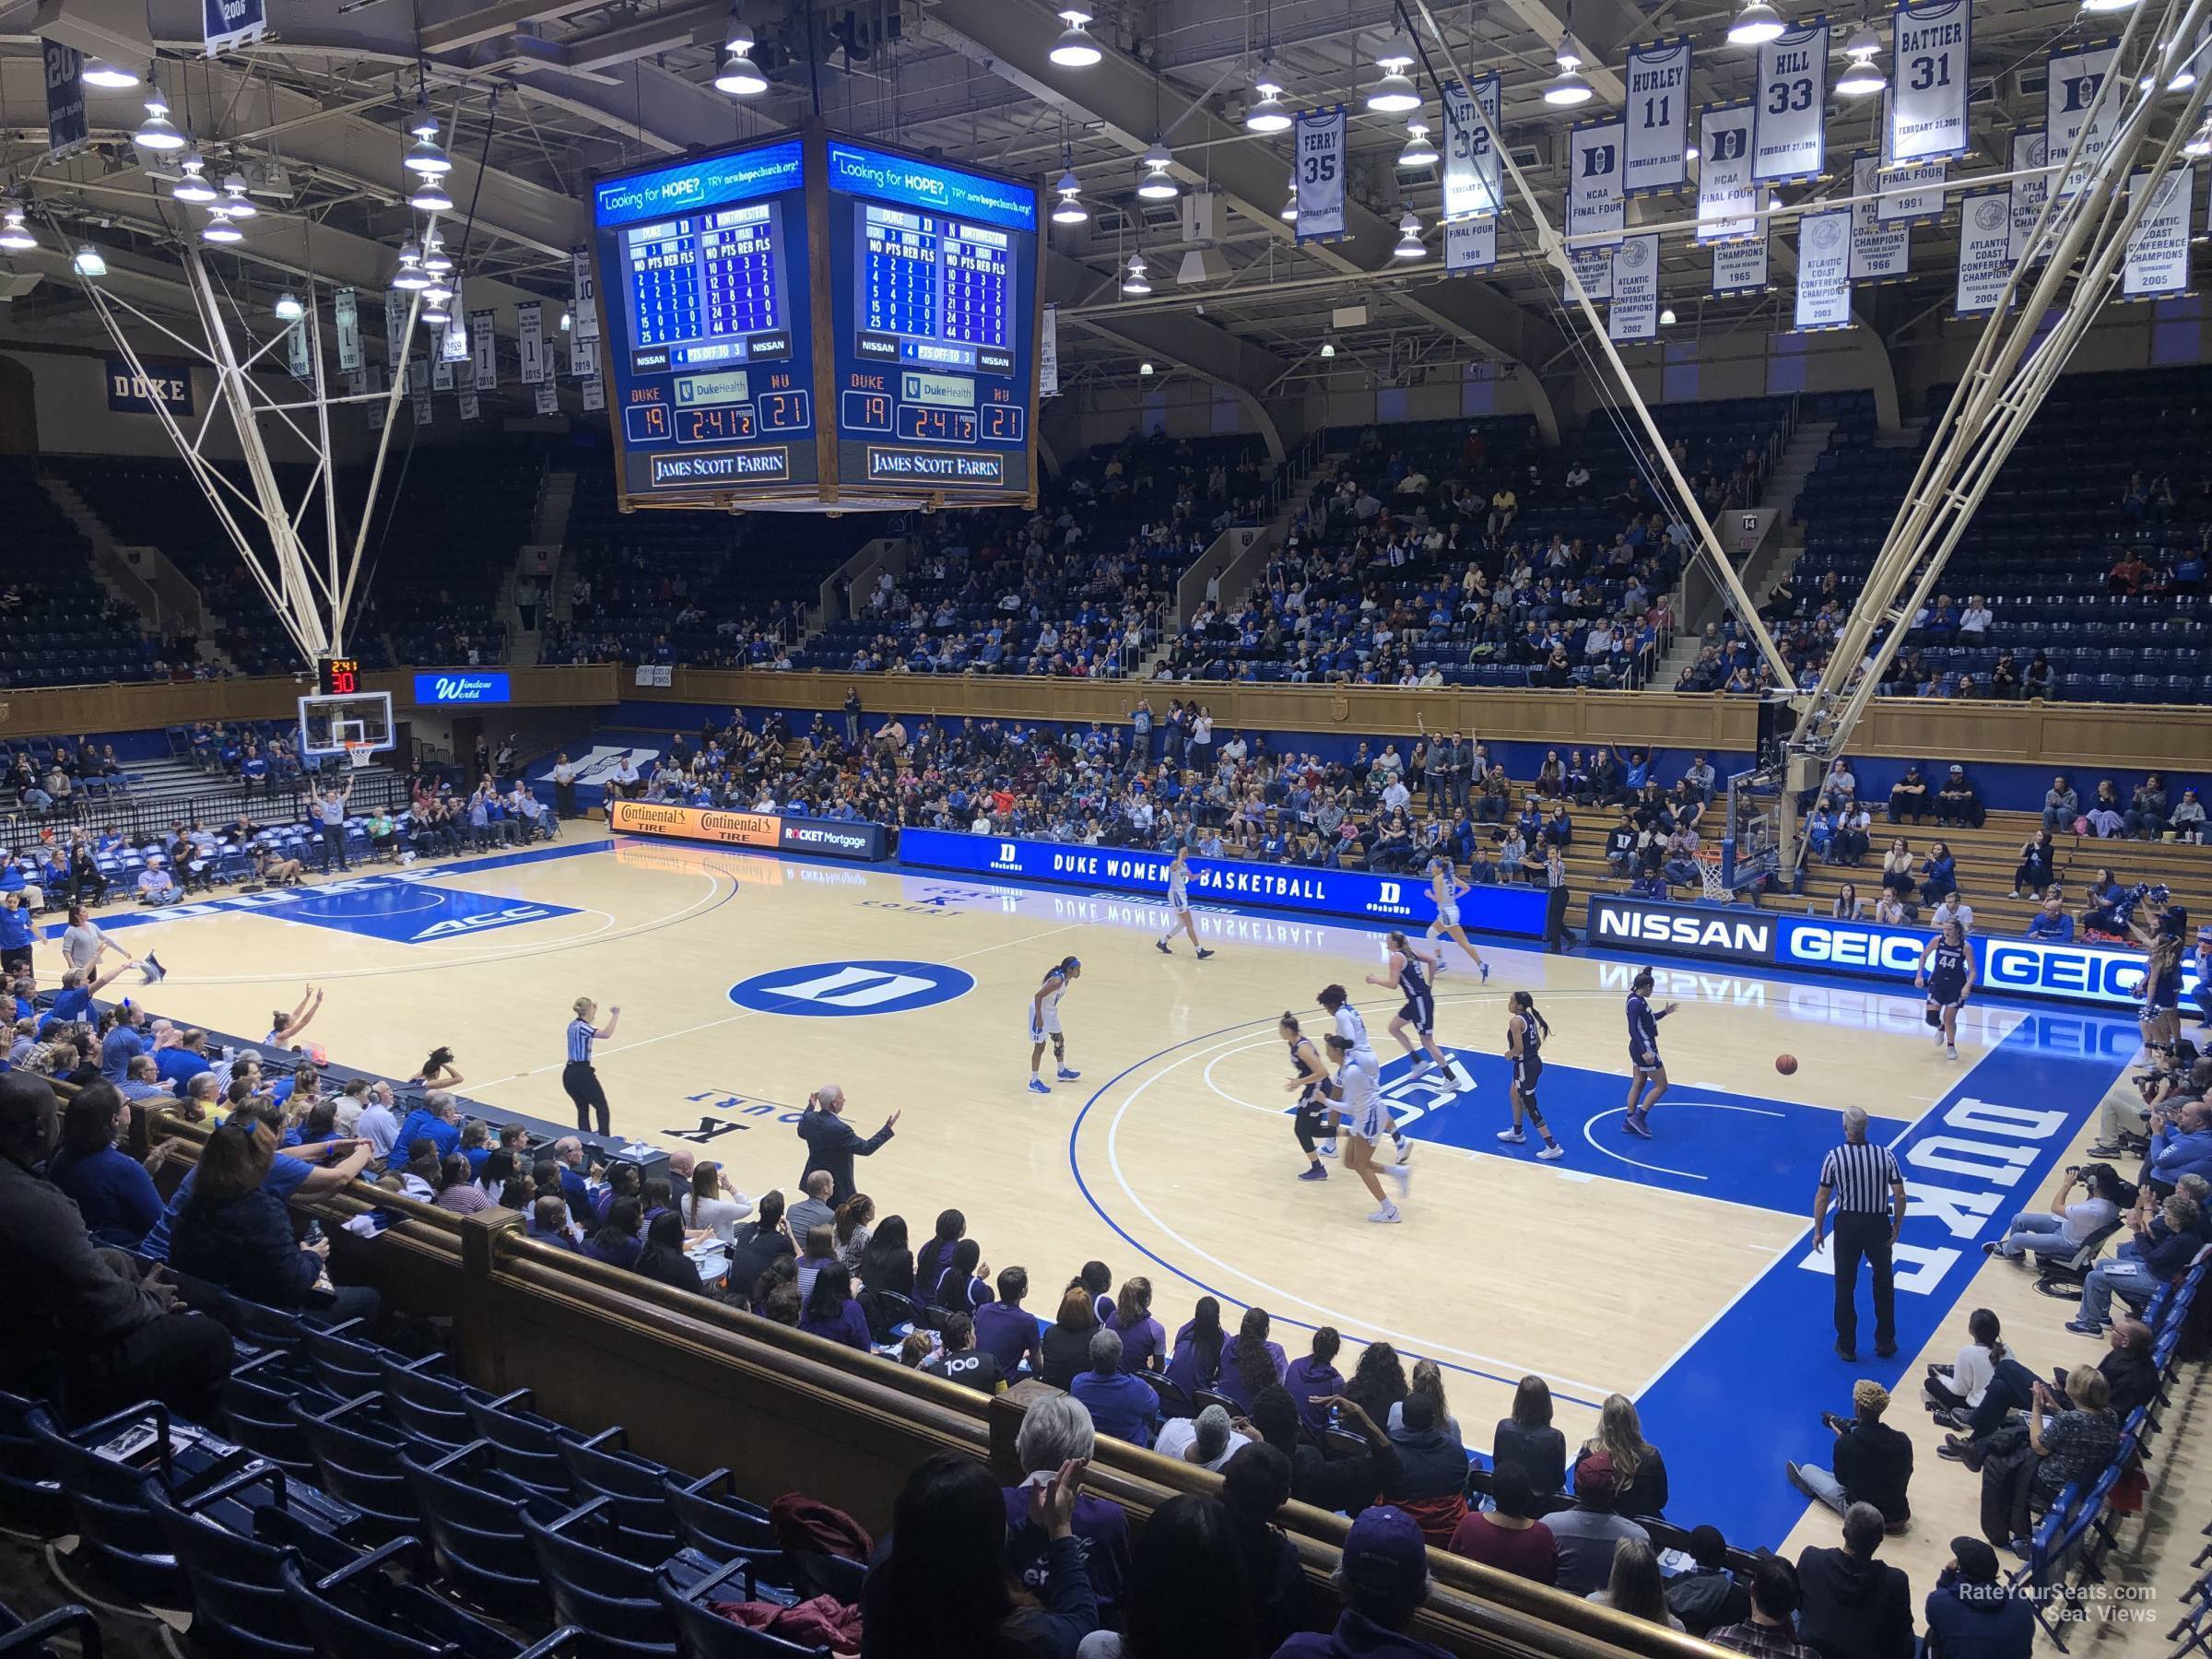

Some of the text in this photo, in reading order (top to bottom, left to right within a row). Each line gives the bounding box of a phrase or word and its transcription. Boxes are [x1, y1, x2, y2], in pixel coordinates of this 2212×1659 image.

[1902, 23, 1961, 53] BATTIER
[1776, 52, 1808, 74] HILL
[1912, 53, 1950, 90] 31
[1633, 66, 1683, 92] HURLEY
[1769, 78, 1813, 114] 33
[1644, 96, 1669, 128] 11
[1899, 118, 1960, 135] FEBRUARY 21,2001
[1305, 132, 1337, 152] FERRY
[1454, 125, 1489, 159] 32
[1304, 154, 1335, 184] 35
[1883, 168, 1942, 184] FINAL FOUR
[841, 159, 883, 187] Looking
[887, 171, 901, 185] for
[905, 175, 944, 195] HOPE?
[952, 187, 965, 199] TRY
[1714, 174, 1738, 184] NCAA
[606, 193, 642, 209] Looking
[645, 189, 659, 201] for
[662, 178, 700, 197] HOPE?
[708, 176, 723, 187] TRY
[1587, 189, 1607, 199] NCAA
[1701, 190, 1753, 203] FINAL FOUR
[1573, 203, 1621, 217] FINAL FOUR
[1899, 197, 1923, 209] 1991
[883, 210, 904, 224] DUKE
[1449, 225, 1493, 238] FINAL FOUR
[1854, 234, 1904, 247] CHAMPIONS
[1971, 238, 2009, 250] ATLANTIC
[706, 239, 771, 259] NO PTS REB FLS
[870, 240, 935, 262] NO PTS REB FLS
[1462, 251, 1480, 260] 1988
[1718, 248, 1763, 261] CHAMPIONS
[1976, 250, 2002, 259] COAST
[634, 252, 694, 271] NO PTS REB FLS
[1808, 258, 1841, 268] ATLANTIC
[2130, 250, 2183, 263] CHAMPIONS
[947, 255, 1005, 275] NO PTS REB FLS
[1867, 260, 1889, 270] 1966
[948, 269, 956, 280] 10
[1730, 272, 1750, 281] 1965
[1813, 268, 1835, 277] COAST
[1618, 276, 1649, 286] ATLANTIC
[1801, 276, 1847, 288] CONFERENCE
[2143, 276, 2167, 286] 2005
[581, 280, 593, 300] 10
[948, 284, 956, 295] 12
[1623, 286, 1644, 294] COAST
[1802, 287, 1844, 299] CHAMPIONS
[948, 299, 955, 309] 21
[1611, 294, 1654, 304] CONFERENCE
[1975, 294, 1998, 303] 2004
[872, 301, 879, 312] 15
[1614, 303, 1653, 313] CHAMPIONS
[871, 316, 880, 327] 25
[947, 312, 956, 324] 24
[346, 327, 351, 347] 1
[947, 327, 956, 337] 44
[528, 341, 535, 361] 1
[753, 341, 784, 352] NISSAN
[863, 341, 894, 353] NISSAN
[482, 349, 488, 369] 1
[575, 361, 590, 371] 2019
[638, 356, 665, 365] NISSAN
[982, 357, 1008, 366] NISSAN
[525, 370, 541, 380] 2015
[771, 374, 789, 388] NU
[852, 374, 884, 390] DUKE
[114, 376, 184, 400] DUKE
[631, 388, 660, 402] DUKE
[697, 382, 745, 395] DukeHealth
[924, 385, 971, 398] DukeHealth
[994, 389, 1009, 402] NU
[773, 397, 800, 425] 21
[866, 398, 884, 424] 19
[646, 408, 664, 434] 19
[693, 411, 736, 439] 2:41
[743, 418, 749, 433] 2
[916, 409, 958, 438] 2:41
[994, 409, 1016, 435] 21
[965, 423, 971, 438] 2
[656, 455, 782, 480] JAMES SCOTT FARRIN
[874, 454, 998, 476] JAMES SCOTT FARRIN
[1746, 520, 1755, 528] 14
[331, 661, 358, 673] 2:41
[332, 673, 354, 693] 30
[621, 805, 677, 823] Continental
[638, 823, 666, 833] TIRE
[701, 812, 763, 832] Continental
[719, 831, 750, 842] TIRE
[824, 832, 865, 848] Mortgage
[1053, 854, 1098, 874] DUKE
[1200, 867, 1325, 900] BASKETBALL
[135, 866, 460, 921] DUKE
[862, 900, 965, 916] COURT
[409, 906, 551, 940] ACC
[1600, 909, 1768, 952] NISSAN
[1939, 956, 1956, 969] 44
[659, 1116, 752, 1144] K
[1798, 1098, 2069, 1295] DUKE
[945, 1357, 979, 1376] 100
